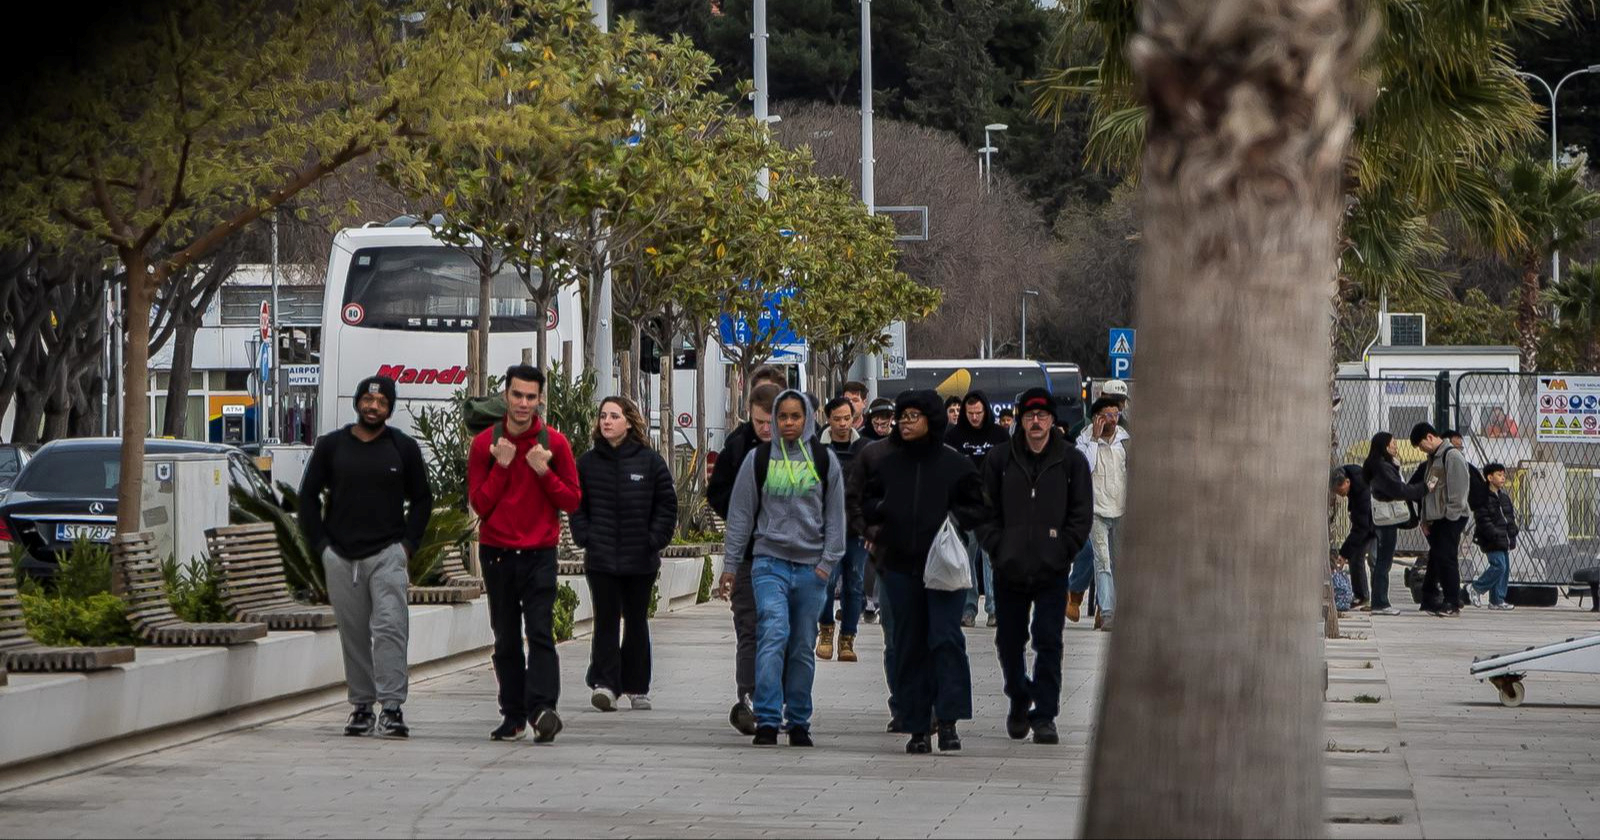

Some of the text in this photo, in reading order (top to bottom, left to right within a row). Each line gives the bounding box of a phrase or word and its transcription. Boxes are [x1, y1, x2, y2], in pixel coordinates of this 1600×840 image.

[407, 317, 491, 329] SETR
[289, 366, 320, 374] AIRPOR
[1115, 358, 1129, 378] P
